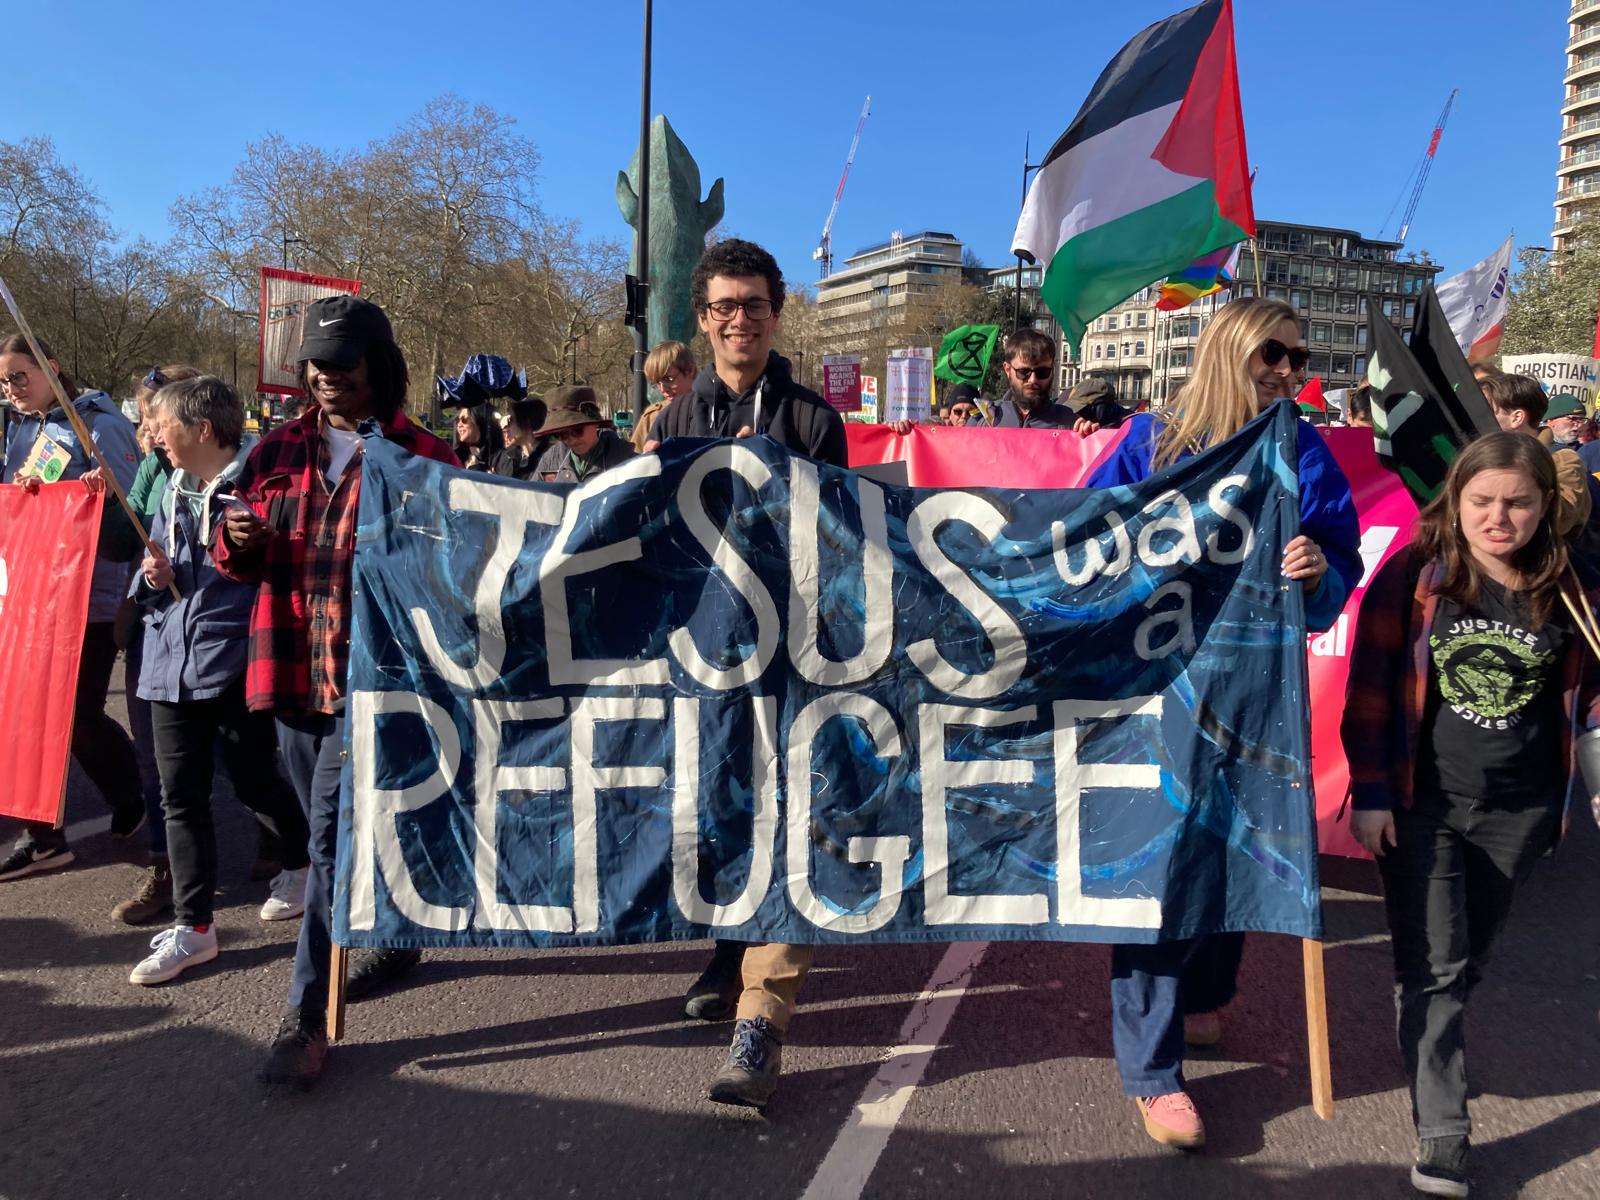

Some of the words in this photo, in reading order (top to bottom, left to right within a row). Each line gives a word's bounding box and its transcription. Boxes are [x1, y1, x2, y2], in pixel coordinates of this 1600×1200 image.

[829, 372, 856, 380] AGAINST
[1514, 362, 1588, 381] CHRISTIAN
[829, 386, 849, 394] RIGHT
[830, 379, 842, 387] THE
[843, 379, 855, 387] FAR
[1549, 383, 1594, 404] ACTION
[411, 443, 1027, 698] JESUS
[1051, 474, 1254, 586] was
[1134, 580, 1196, 661] a
[1448, 619, 1539, 647] JUSTICE
[348, 690, 1164, 934] REFUGEE
